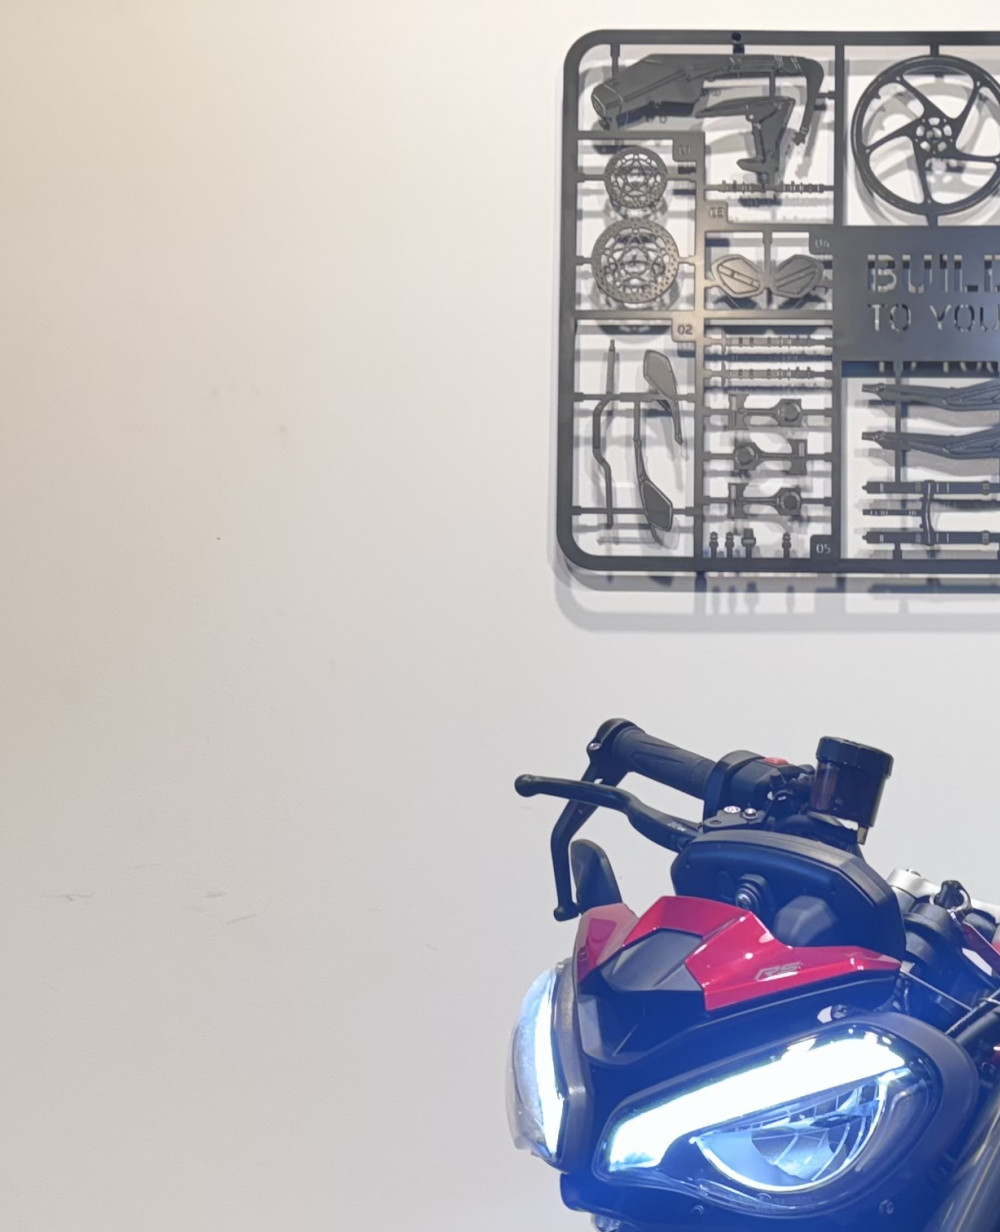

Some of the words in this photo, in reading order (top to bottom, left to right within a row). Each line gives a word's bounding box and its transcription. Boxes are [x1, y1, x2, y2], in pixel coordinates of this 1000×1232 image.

[866, 303, 911, 332] TO
[677, 323, 694, 335] 02
[815, 543, 832, 554] 05
